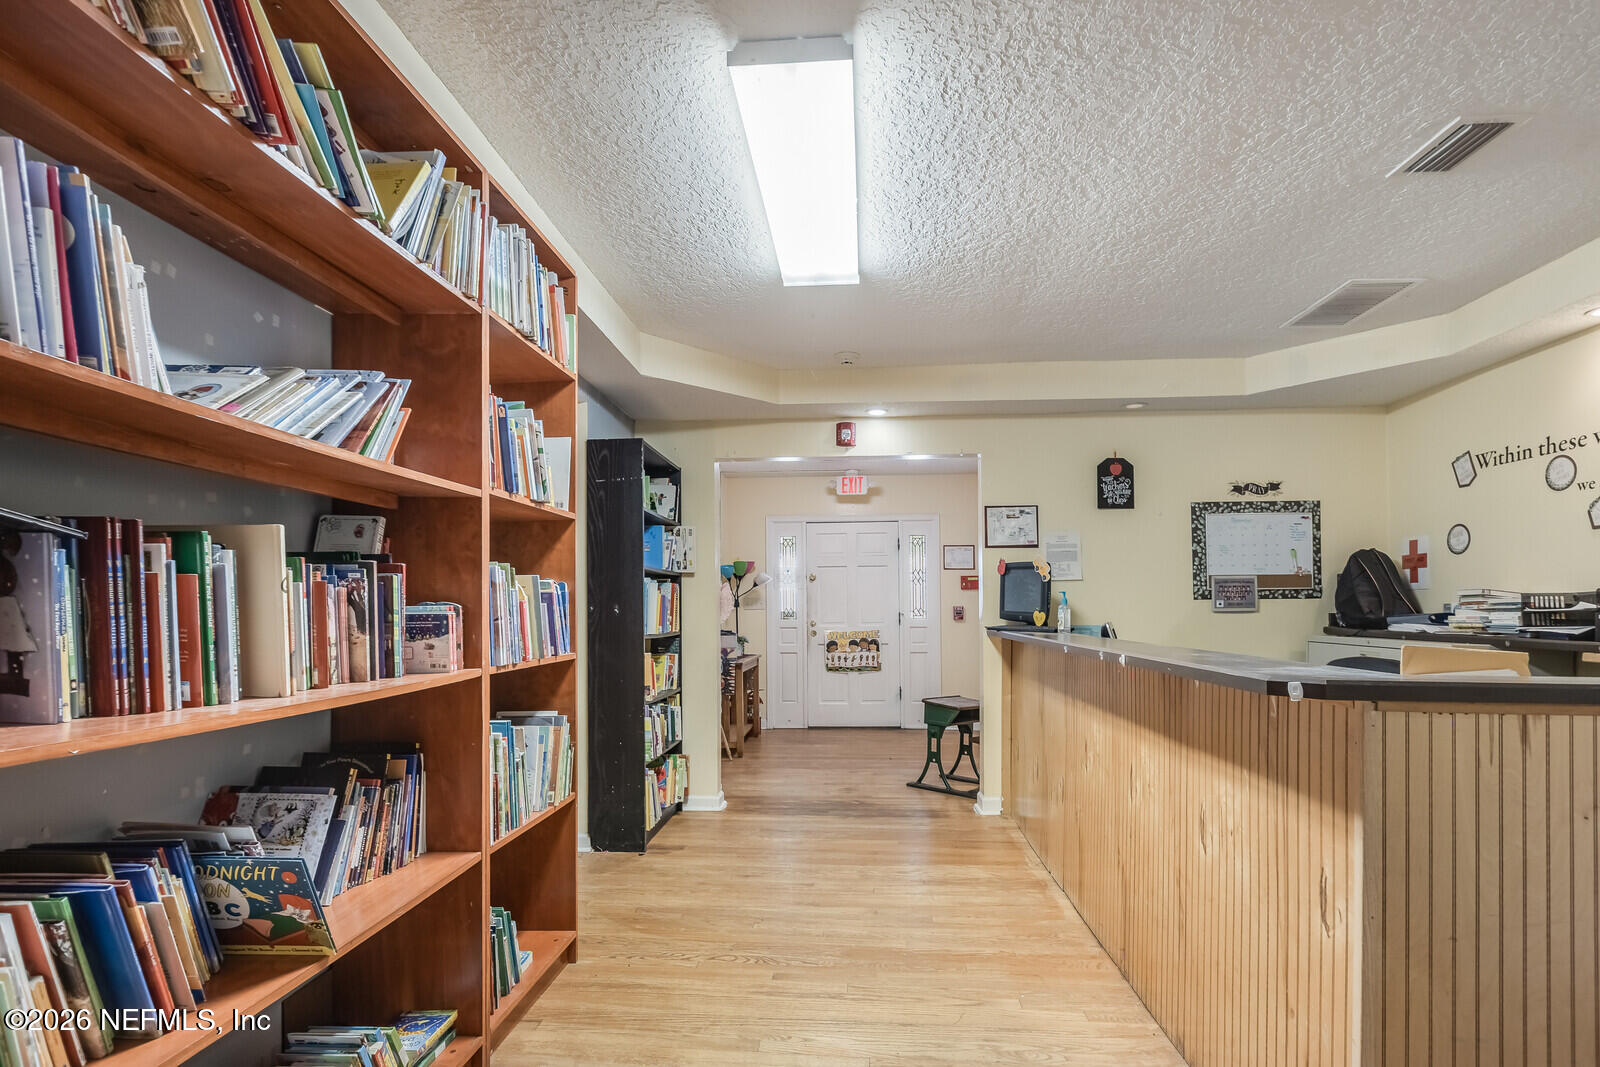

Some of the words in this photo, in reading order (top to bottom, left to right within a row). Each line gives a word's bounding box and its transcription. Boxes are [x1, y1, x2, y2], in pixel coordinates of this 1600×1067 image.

[1474, 445, 1533, 469] Within
[1539, 435, 1588, 456] these
[842, 476, 864, 493] EXIT
[1247, 482, 1267, 494] PRAY
[1577, 480, 1596, 491] we
[827, 630, 880, 641] WELCOME
[194, 864, 280, 881] ODNIGHT
[203, 883, 231, 898] ON
